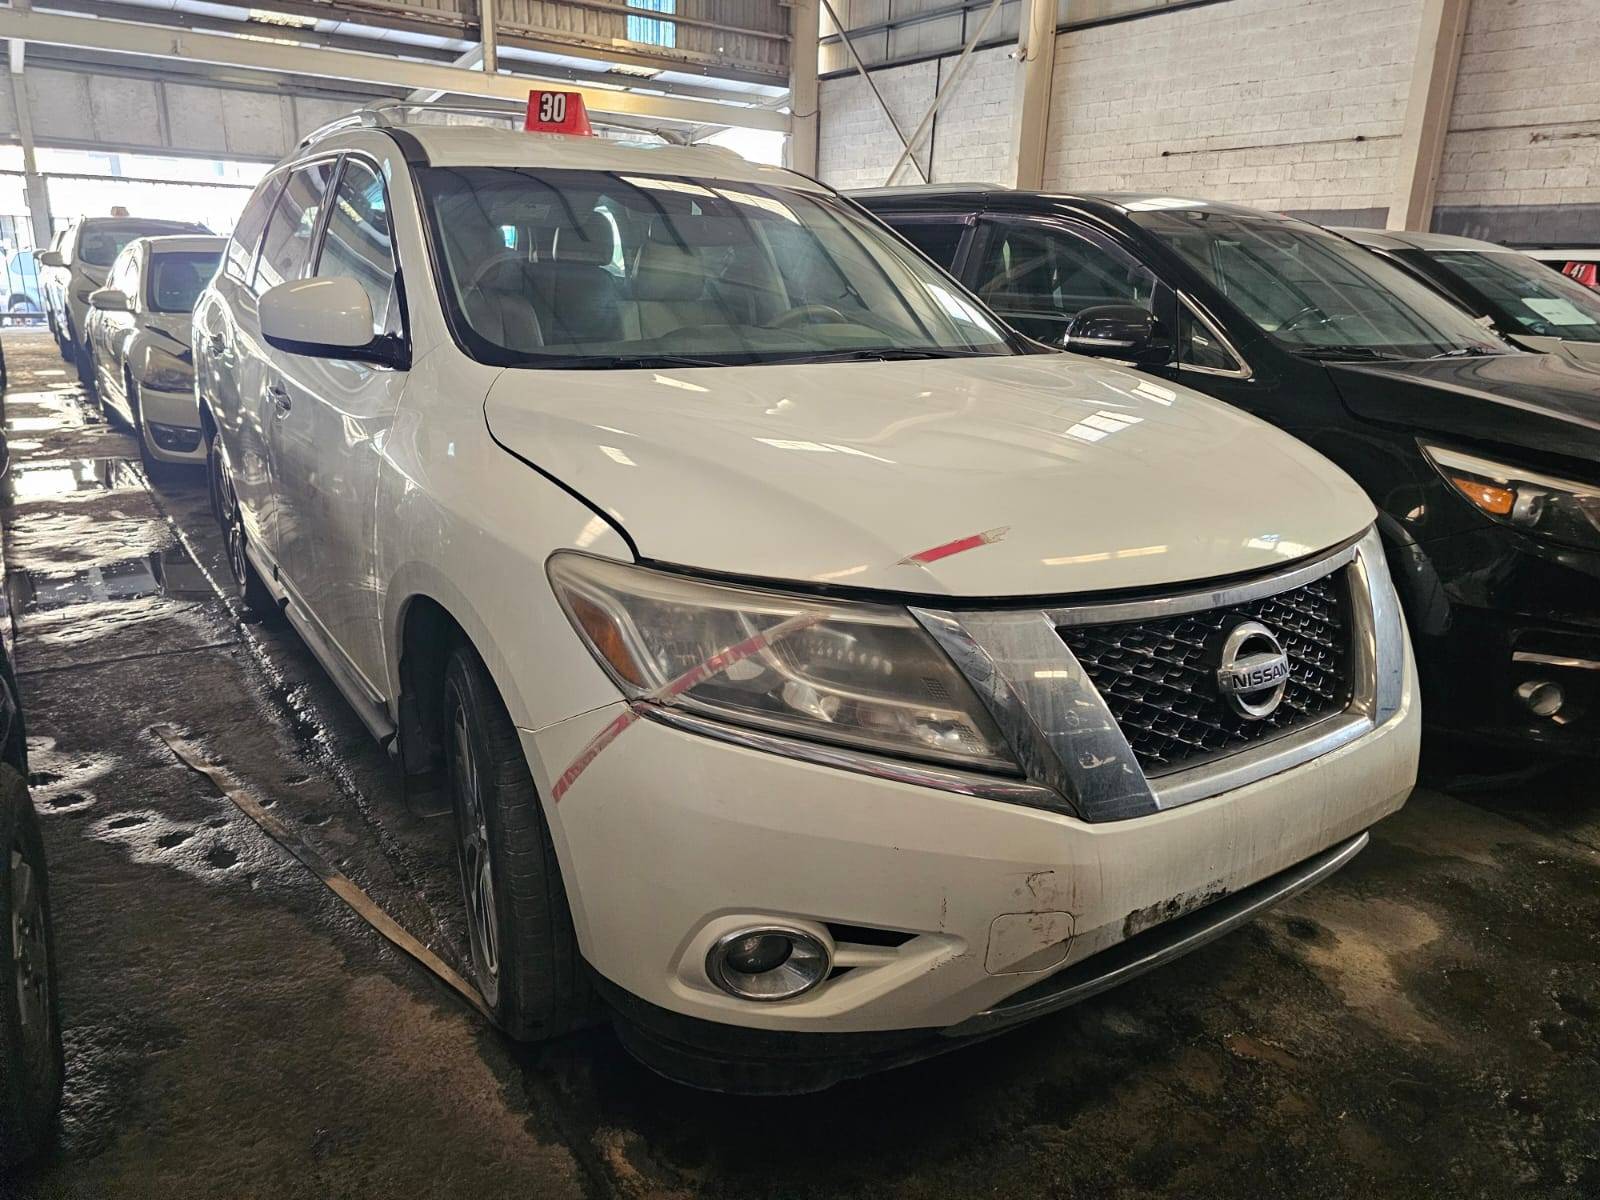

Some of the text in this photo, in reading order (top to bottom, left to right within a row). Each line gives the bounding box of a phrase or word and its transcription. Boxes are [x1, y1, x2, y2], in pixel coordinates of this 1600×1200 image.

[540, 93, 566, 122] 30
[1570, 264, 1586, 278] 41
[1232, 661, 1288, 689] NISSAN
